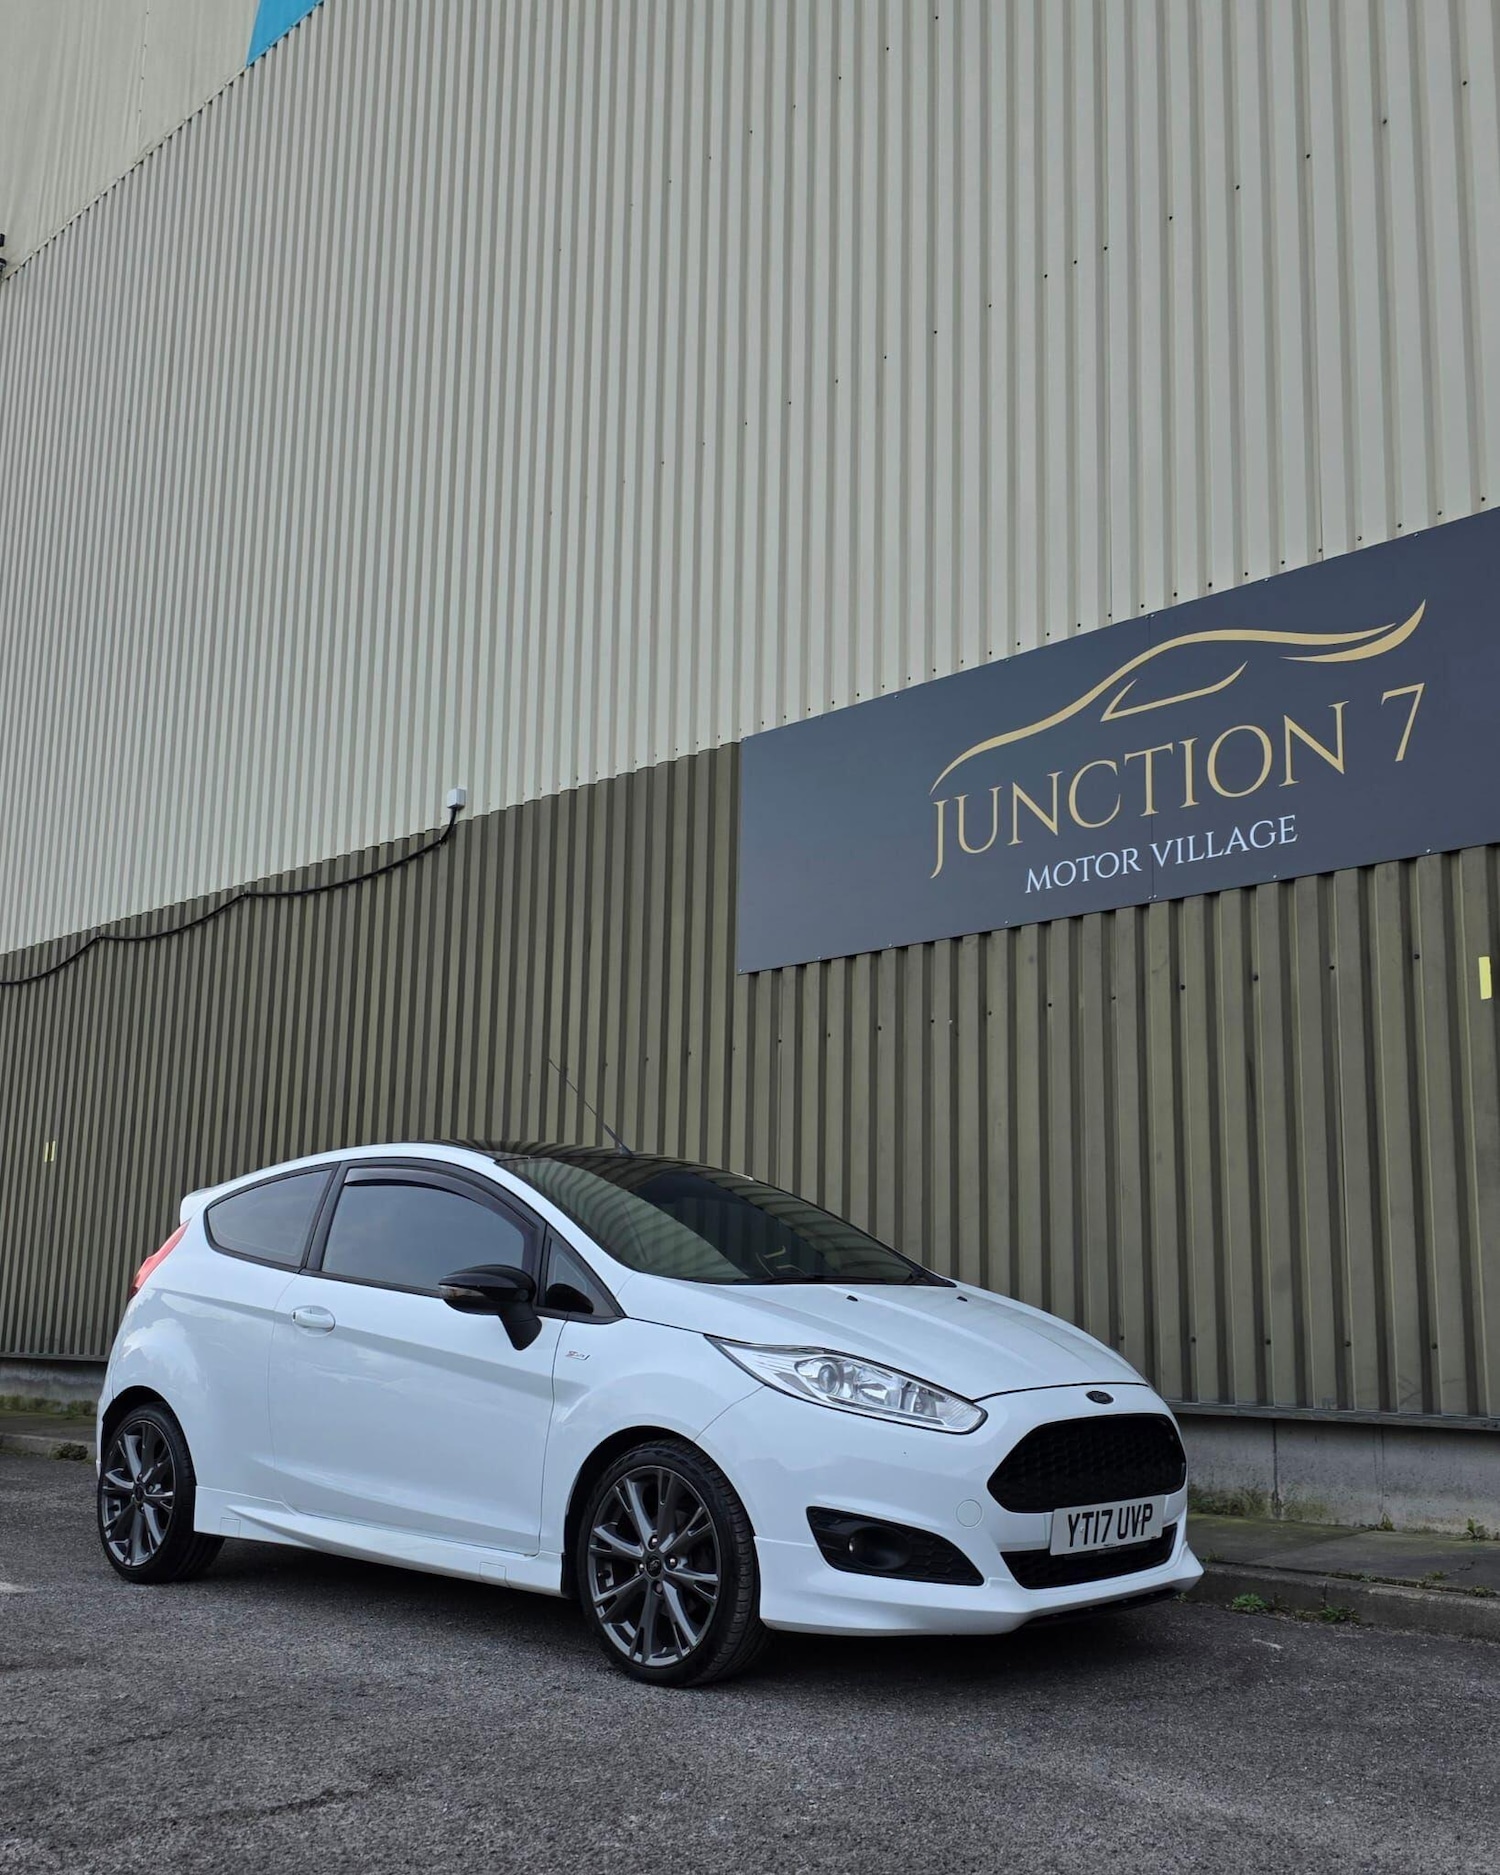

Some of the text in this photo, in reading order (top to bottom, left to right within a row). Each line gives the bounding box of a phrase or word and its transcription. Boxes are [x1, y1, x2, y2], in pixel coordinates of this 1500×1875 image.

[930, 682, 1425, 879] JUNCTION 7
[1024, 814, 1299, 894] MOTOR VILLAGE
[1068, 1503, 1153, 1547] YT17 UVP
